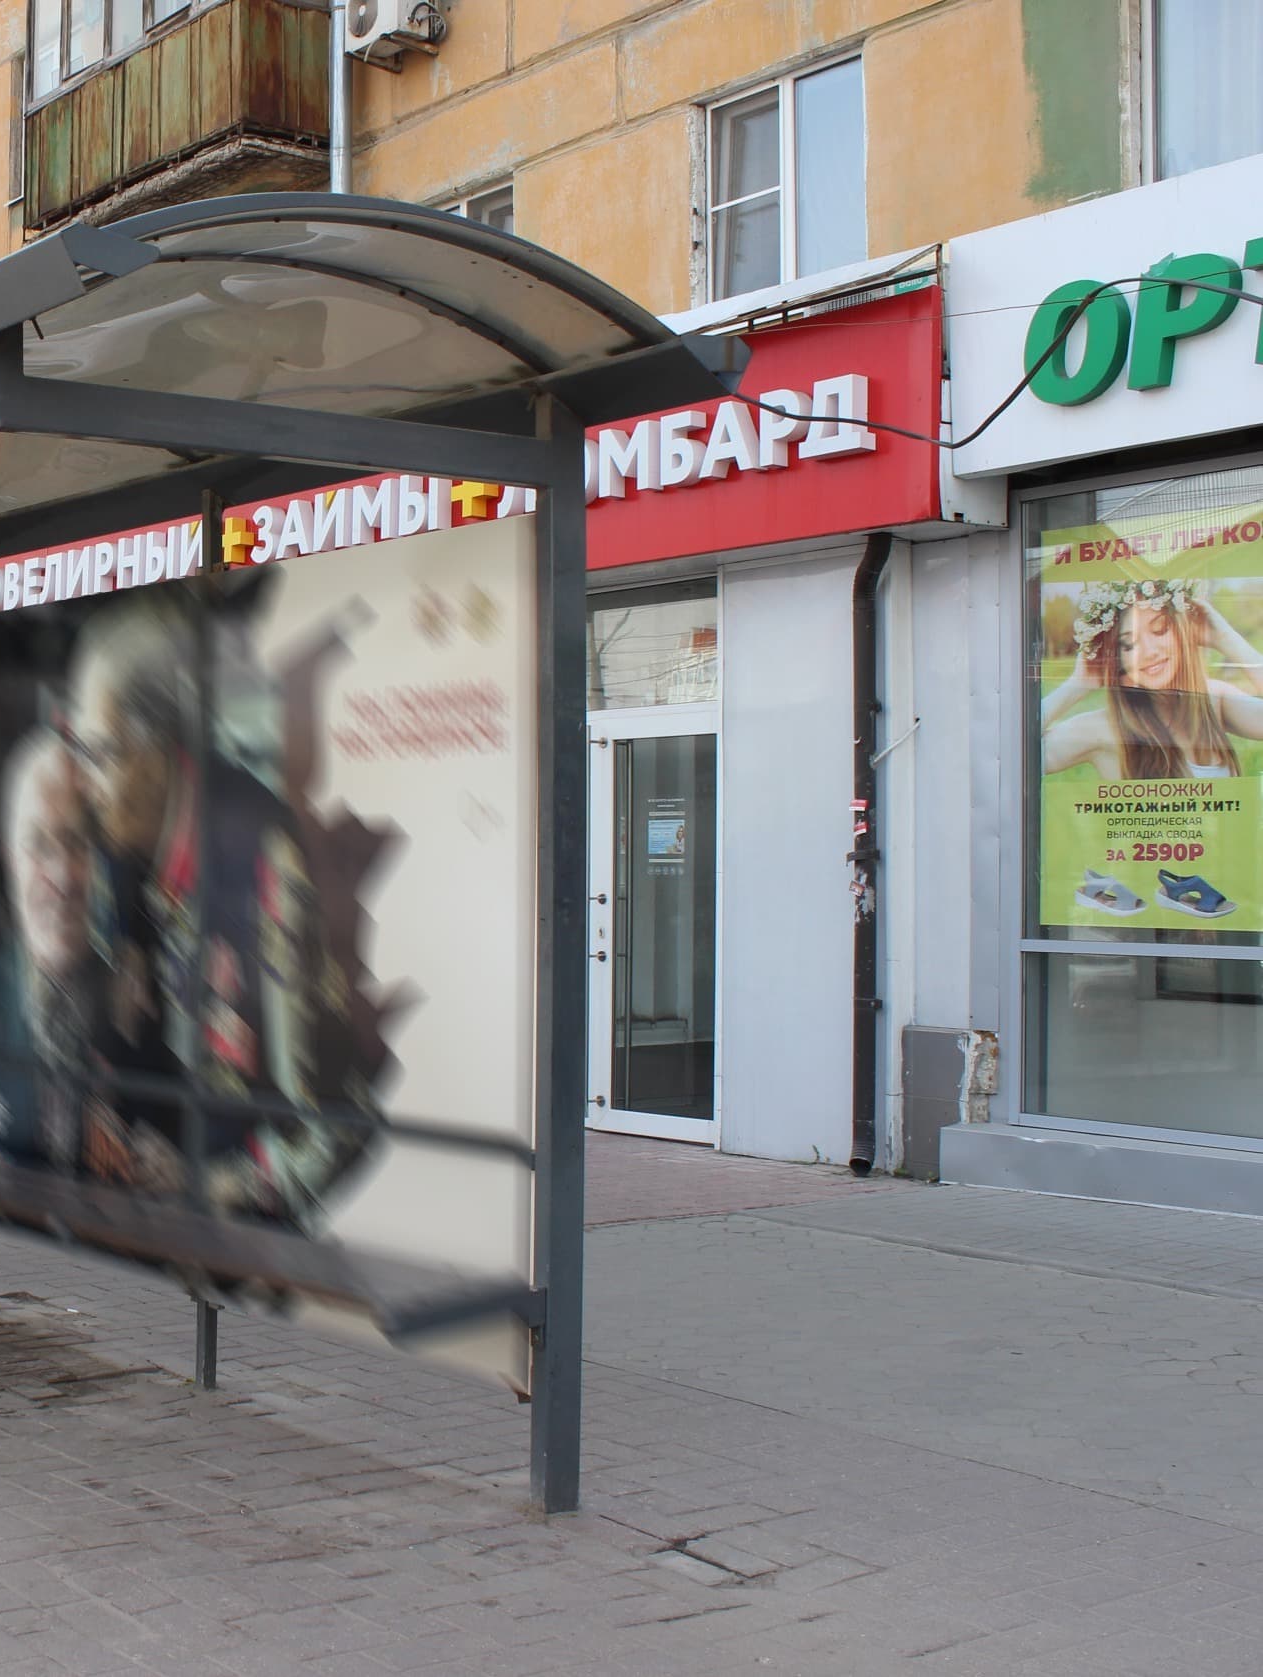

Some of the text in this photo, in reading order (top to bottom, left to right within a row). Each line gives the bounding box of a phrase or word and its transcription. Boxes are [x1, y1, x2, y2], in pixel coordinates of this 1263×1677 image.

[1024, 237, 1263, 406] ОР
[251, 474, 452, 563] ЗАЙМЫ
[1055, 544, 1071, 565] И
[1079, 532, 1161, 562] БУДЕТ
[1098, 783, 1214, 799] БОСОНОЖКИ
[1074, 799, 1240, 814] ТРИКОТАЖНЫЙ ХИТ!
[1107, 817, 1202, 826] ОРТОПЕДИЧЕСКАЯ
[1107, 830, 1202, 840] ВЫКЛАДКА СВОДА
[1106, 843, 1204, 861] ЗА 2590Р
